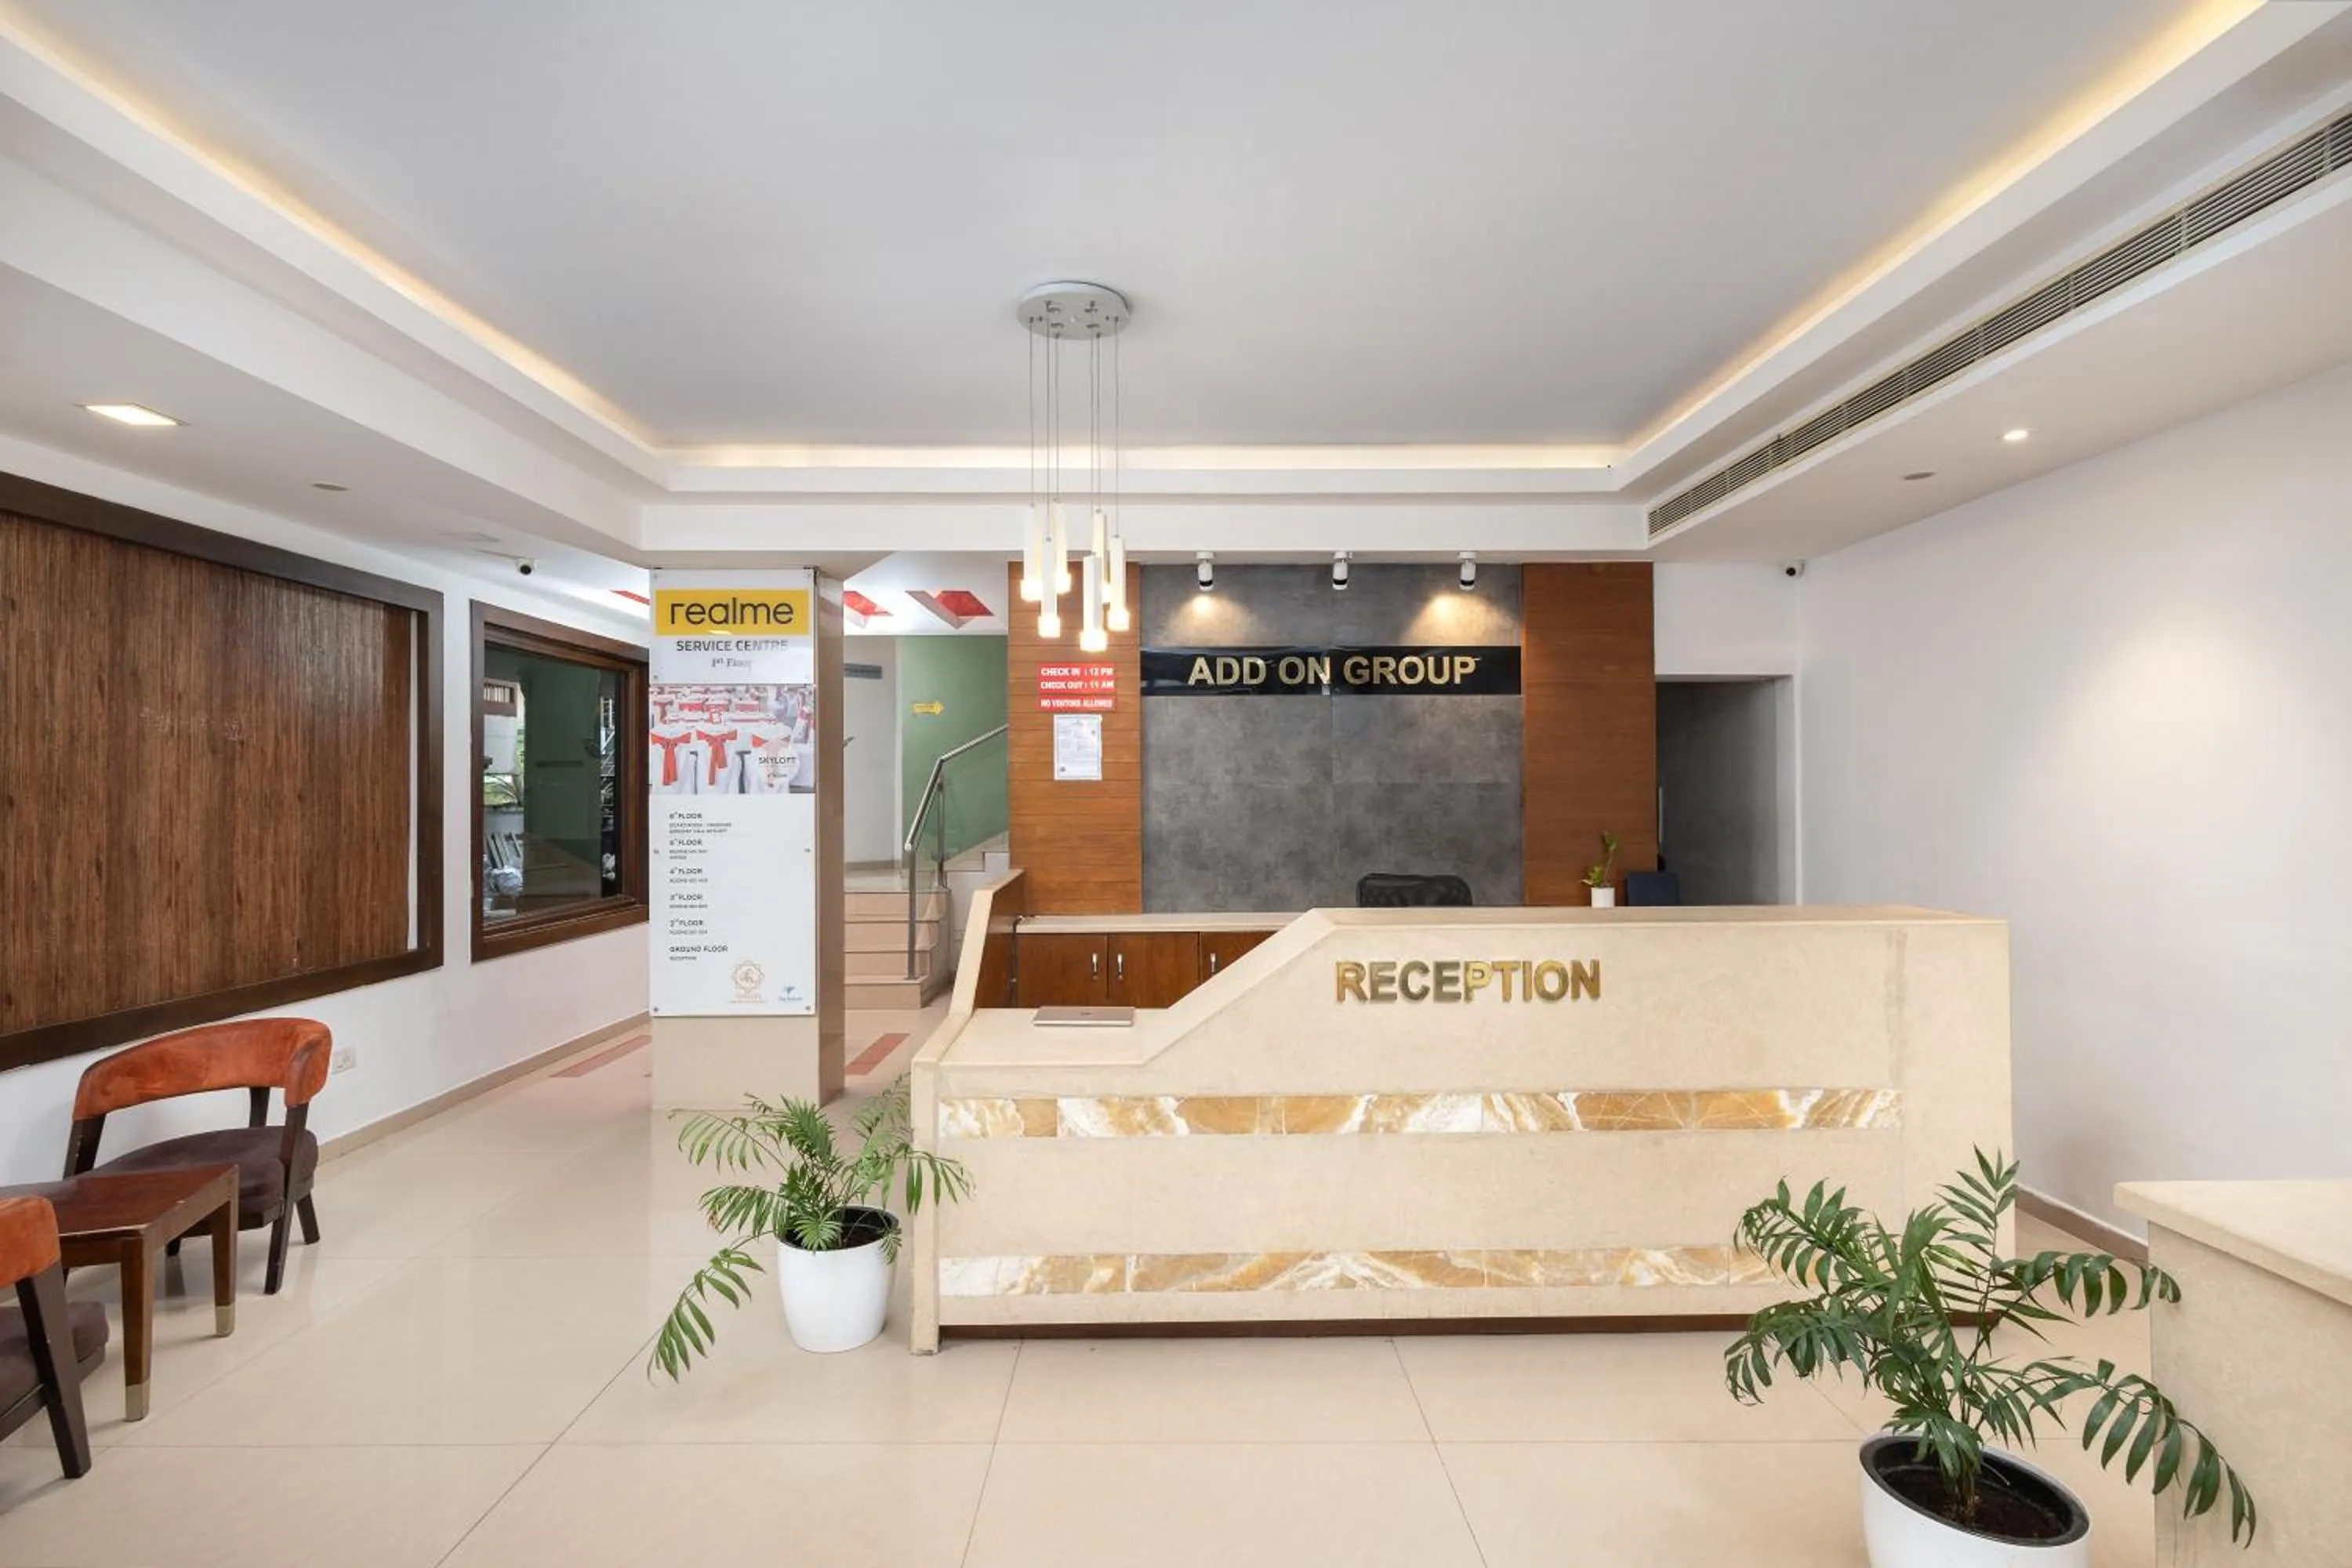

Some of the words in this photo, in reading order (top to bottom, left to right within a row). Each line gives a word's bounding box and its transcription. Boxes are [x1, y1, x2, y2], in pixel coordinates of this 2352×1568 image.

[670, 597, 794, 625] realme
[677, 640, 733, 652] SERVICE
[1040, 667, 1070, 677] CHECK
[1071, 667, 1080, 676] IN
[1188, 656, 1266, 685] ADD
[1279, 656, 1331, 685] ON
[1344, 656, 1477, 685] GROUP
[1040, 681, 1067, 689] CHECK
[1067, 681, 1083, 689] OUT
[1090, 681, 1099, 689] 11
[1040, 699, 1051, 707] NO
[1335, 959, 1601, 1003] RECEPTION
